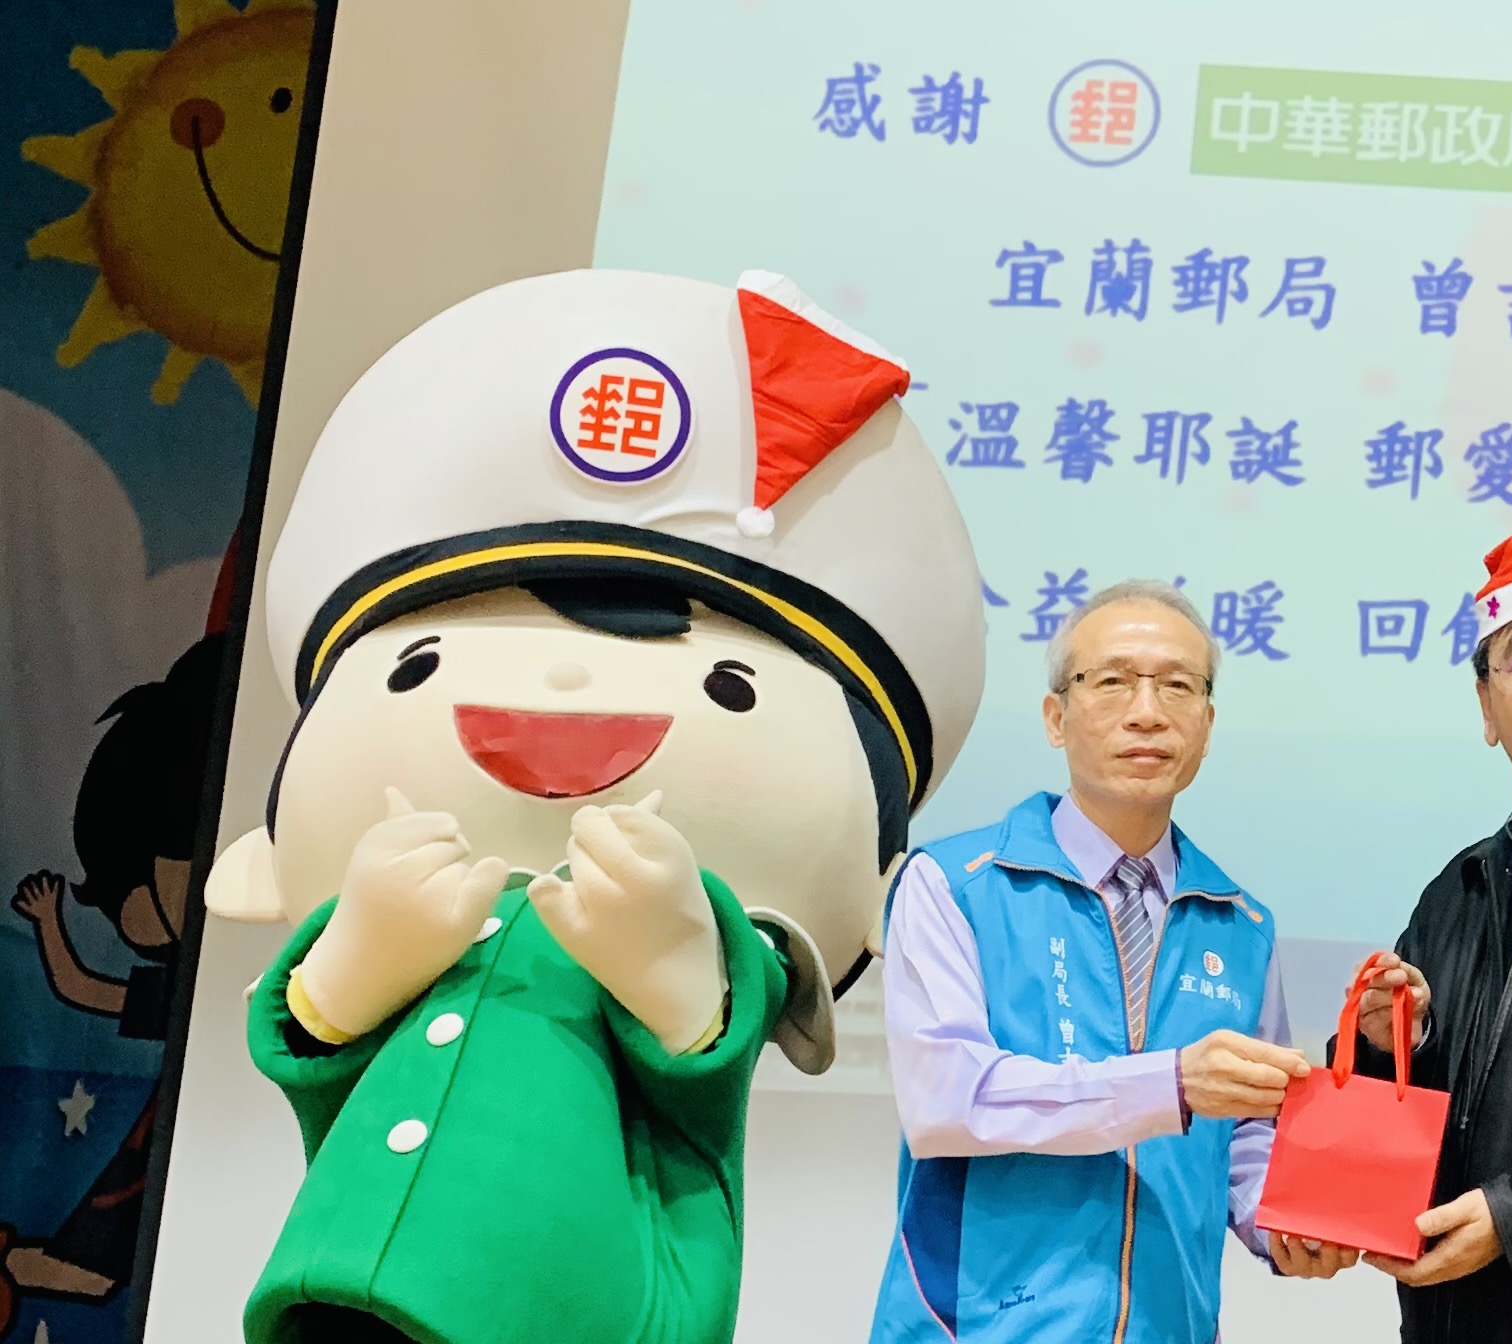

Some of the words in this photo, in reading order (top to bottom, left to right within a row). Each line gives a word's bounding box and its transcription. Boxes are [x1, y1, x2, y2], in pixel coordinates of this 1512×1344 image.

[814, 61, 991, 146] 感謝
[989, 238, 1337, 331] 宜蘭郵局
[576, 374, 666, 459] 郵
[1049, 936, 1072, 1008] 副局長
[1179, 973, 1241, 1011] 宜蘭郵局
